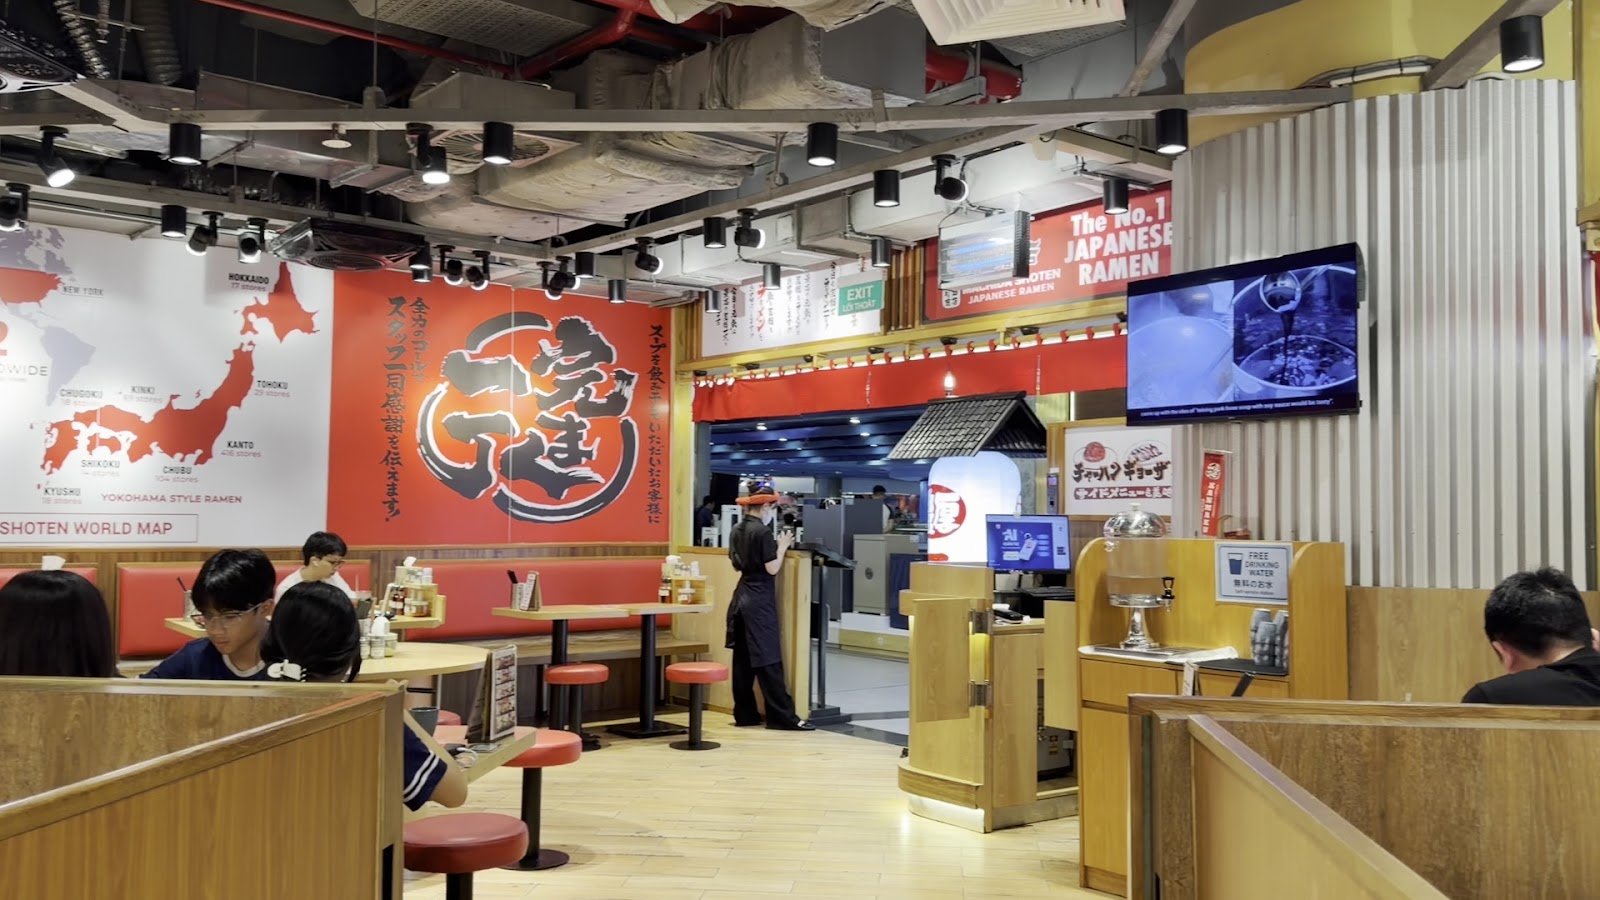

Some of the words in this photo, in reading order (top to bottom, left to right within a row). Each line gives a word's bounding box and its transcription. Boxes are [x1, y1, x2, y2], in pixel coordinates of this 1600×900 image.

[1070, 211, 1107, 237] The
[1064, 222, 1173, 264] JAPANESE
[1078, 251, 1159, 286] RAMEN
[229, 273, 269, 284] HOKKAIDO
[63, 285, 80, 294] NEW
[83, 287, 104, 296] YORK
[847, 285, 874, 301] EXIT
[968, 291, 1016, 304] JAPANESE
[1019, 283, 1055, 295] RAMEN
[257, 380, 289, 390] TOHOKU
[60, 388, 103, 398] CHUGOKU
[131, 386, 156, 395] KINKI
[266, 390, 291, 398] stores
[646, 324, 667, 524] スープを飲み干いただいたお客様に
[227, 440, 255, 450] KANTO
[236, 450, 261, 458] stores
[81, 459, 120, 468] SHIKOKU
[163, 466, 192, 475] CHUBU
[44, 487, 81, 497] KYUSHU
[101, 494, 166, 503] YOKOHAMA
[169, 495, 202, 503] STYLE
[204, 495, 242, 504] RAMEN
[0, 522, 69, 535] SHOTEN
[73, 522, 132, 535] WORLD
[137, 522, 173, 535] MAP
[1249, 551, 1269, 560] FREE
[1245, 561, 1280, 569] DRINKING
[1248, 569, 1275, 577] WATER
[1234, 579, 1274, 589] 無料のお水
